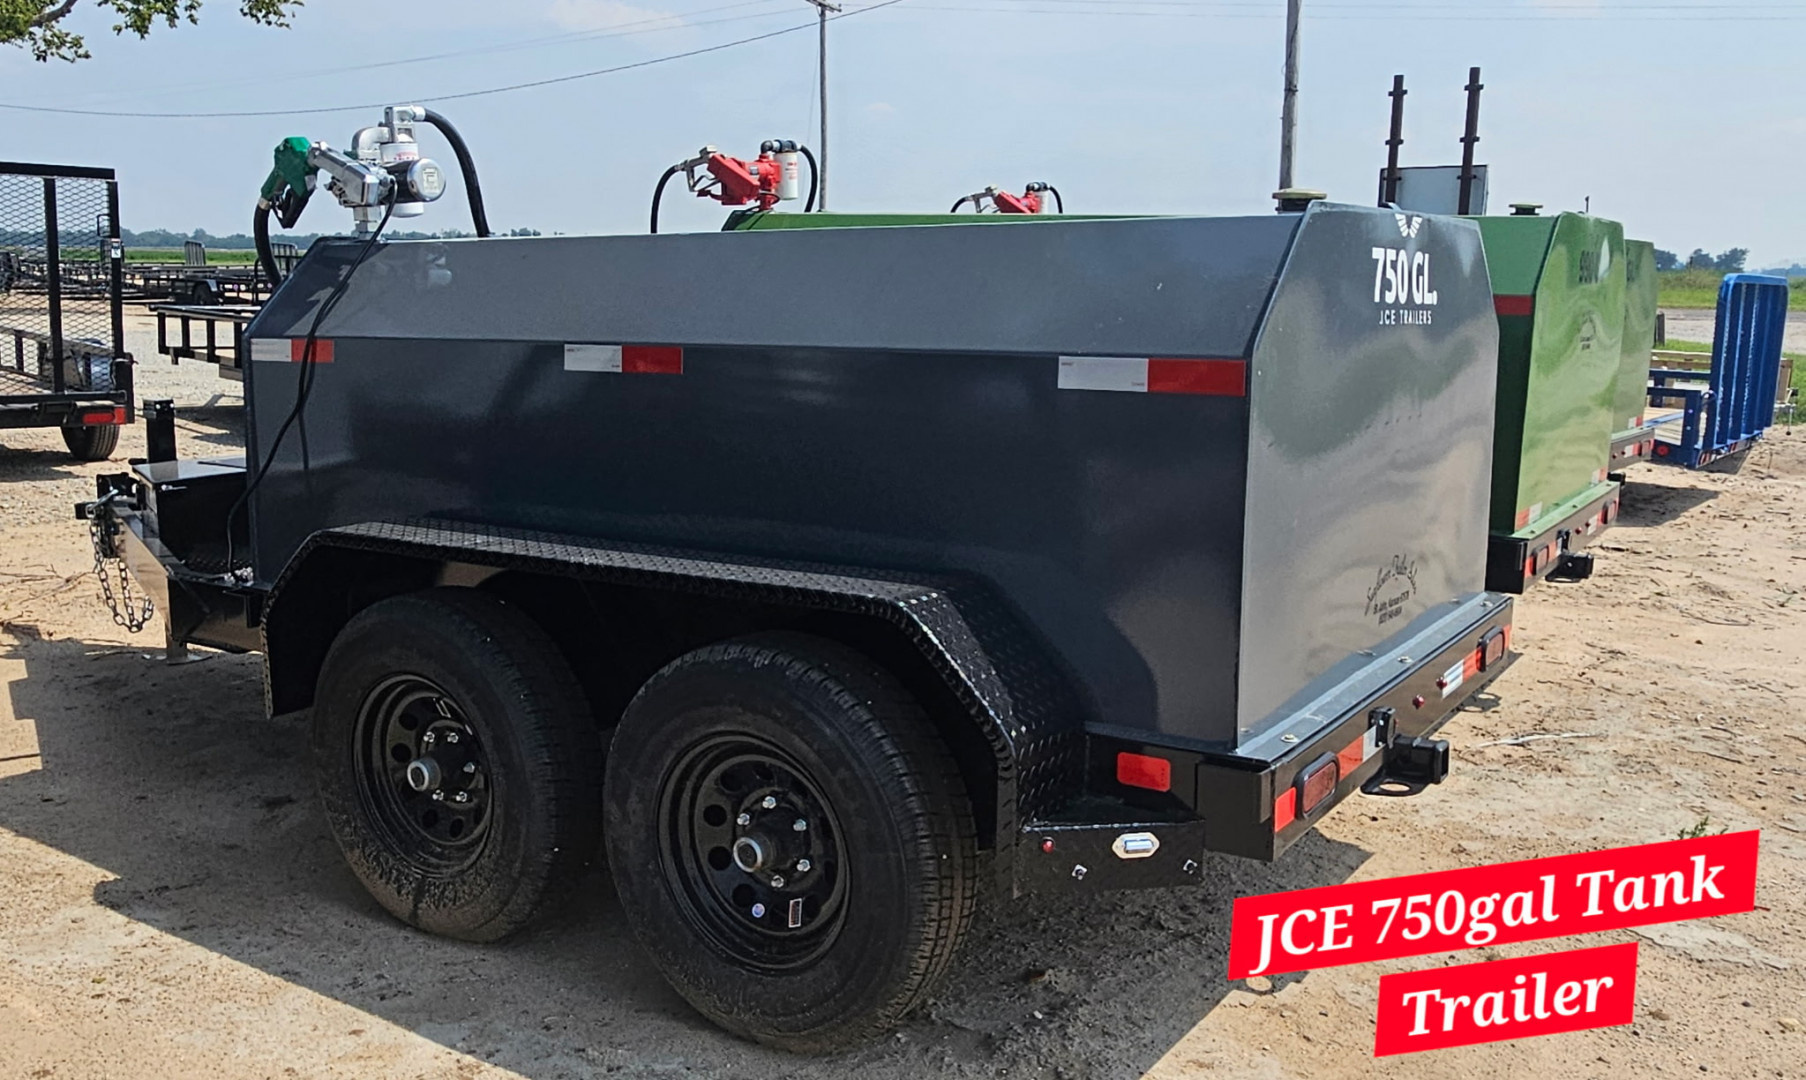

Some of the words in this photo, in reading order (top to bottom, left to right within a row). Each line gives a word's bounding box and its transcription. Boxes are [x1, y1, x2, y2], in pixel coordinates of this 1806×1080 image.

[1372, 247, 1409, 305] 750
[1412, 250, 1438, 306] GL.
[1379, 309, 1396, 325] JCE
[1400, 309, 1432, 325] TRAILERS
